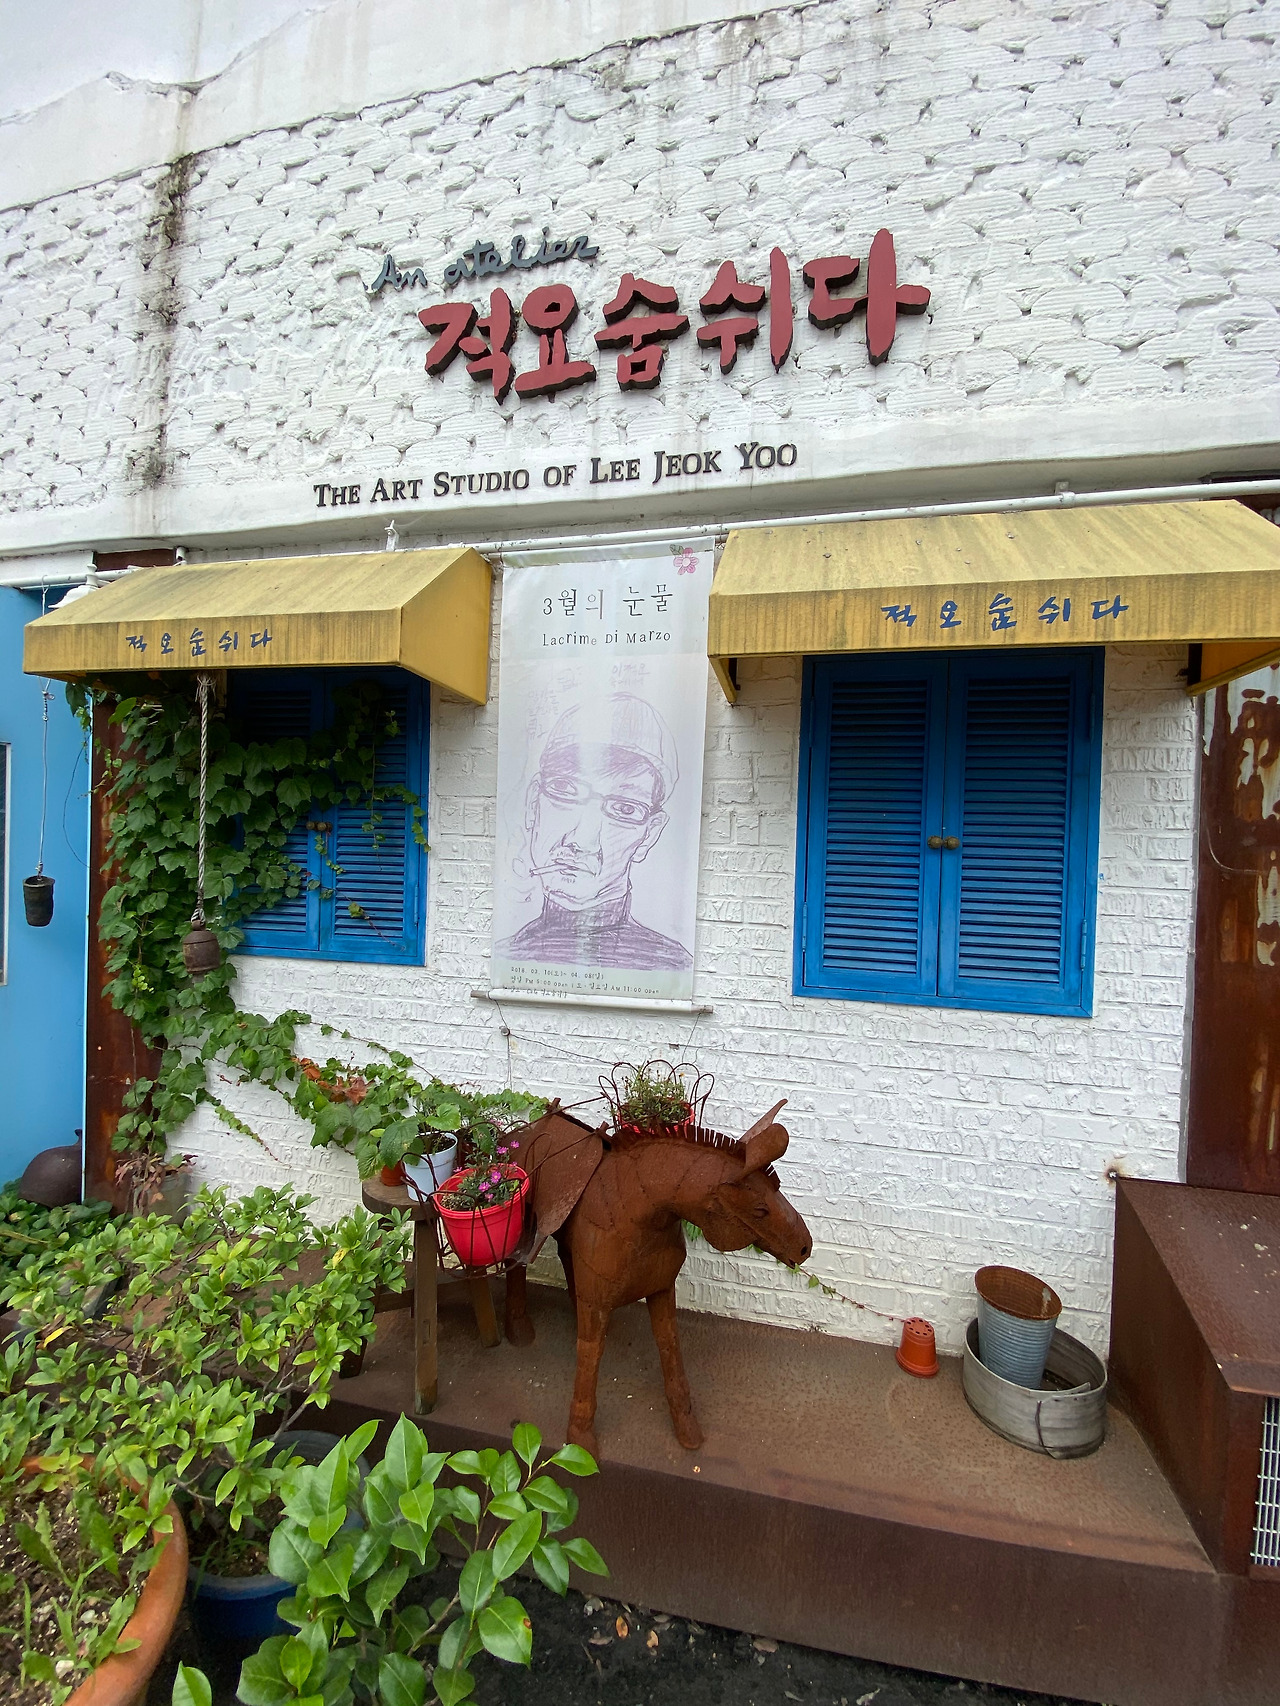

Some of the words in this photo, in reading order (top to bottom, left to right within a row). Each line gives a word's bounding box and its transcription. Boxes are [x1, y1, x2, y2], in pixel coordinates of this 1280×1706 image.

[365, 254, 427, 291] An
[443, 227, 599, 285] atelier
[313, 483, 361, 508] THE
[370, 477, 423, 503] ART
[433, 468, 531, 498] STUDIO
[543, 464, 577, 487] OF
[589, 456, 641, 484] LEE
[652, 449, 722, 484] JEOK
[735, 443, 798, 471] YOO
[543, 588, 604, 620] 3월의
[622, 583, 674, 617] 눈물
[542, 630, 598, 647] Lacrime
[626, 630, 671, 644] Marzo
